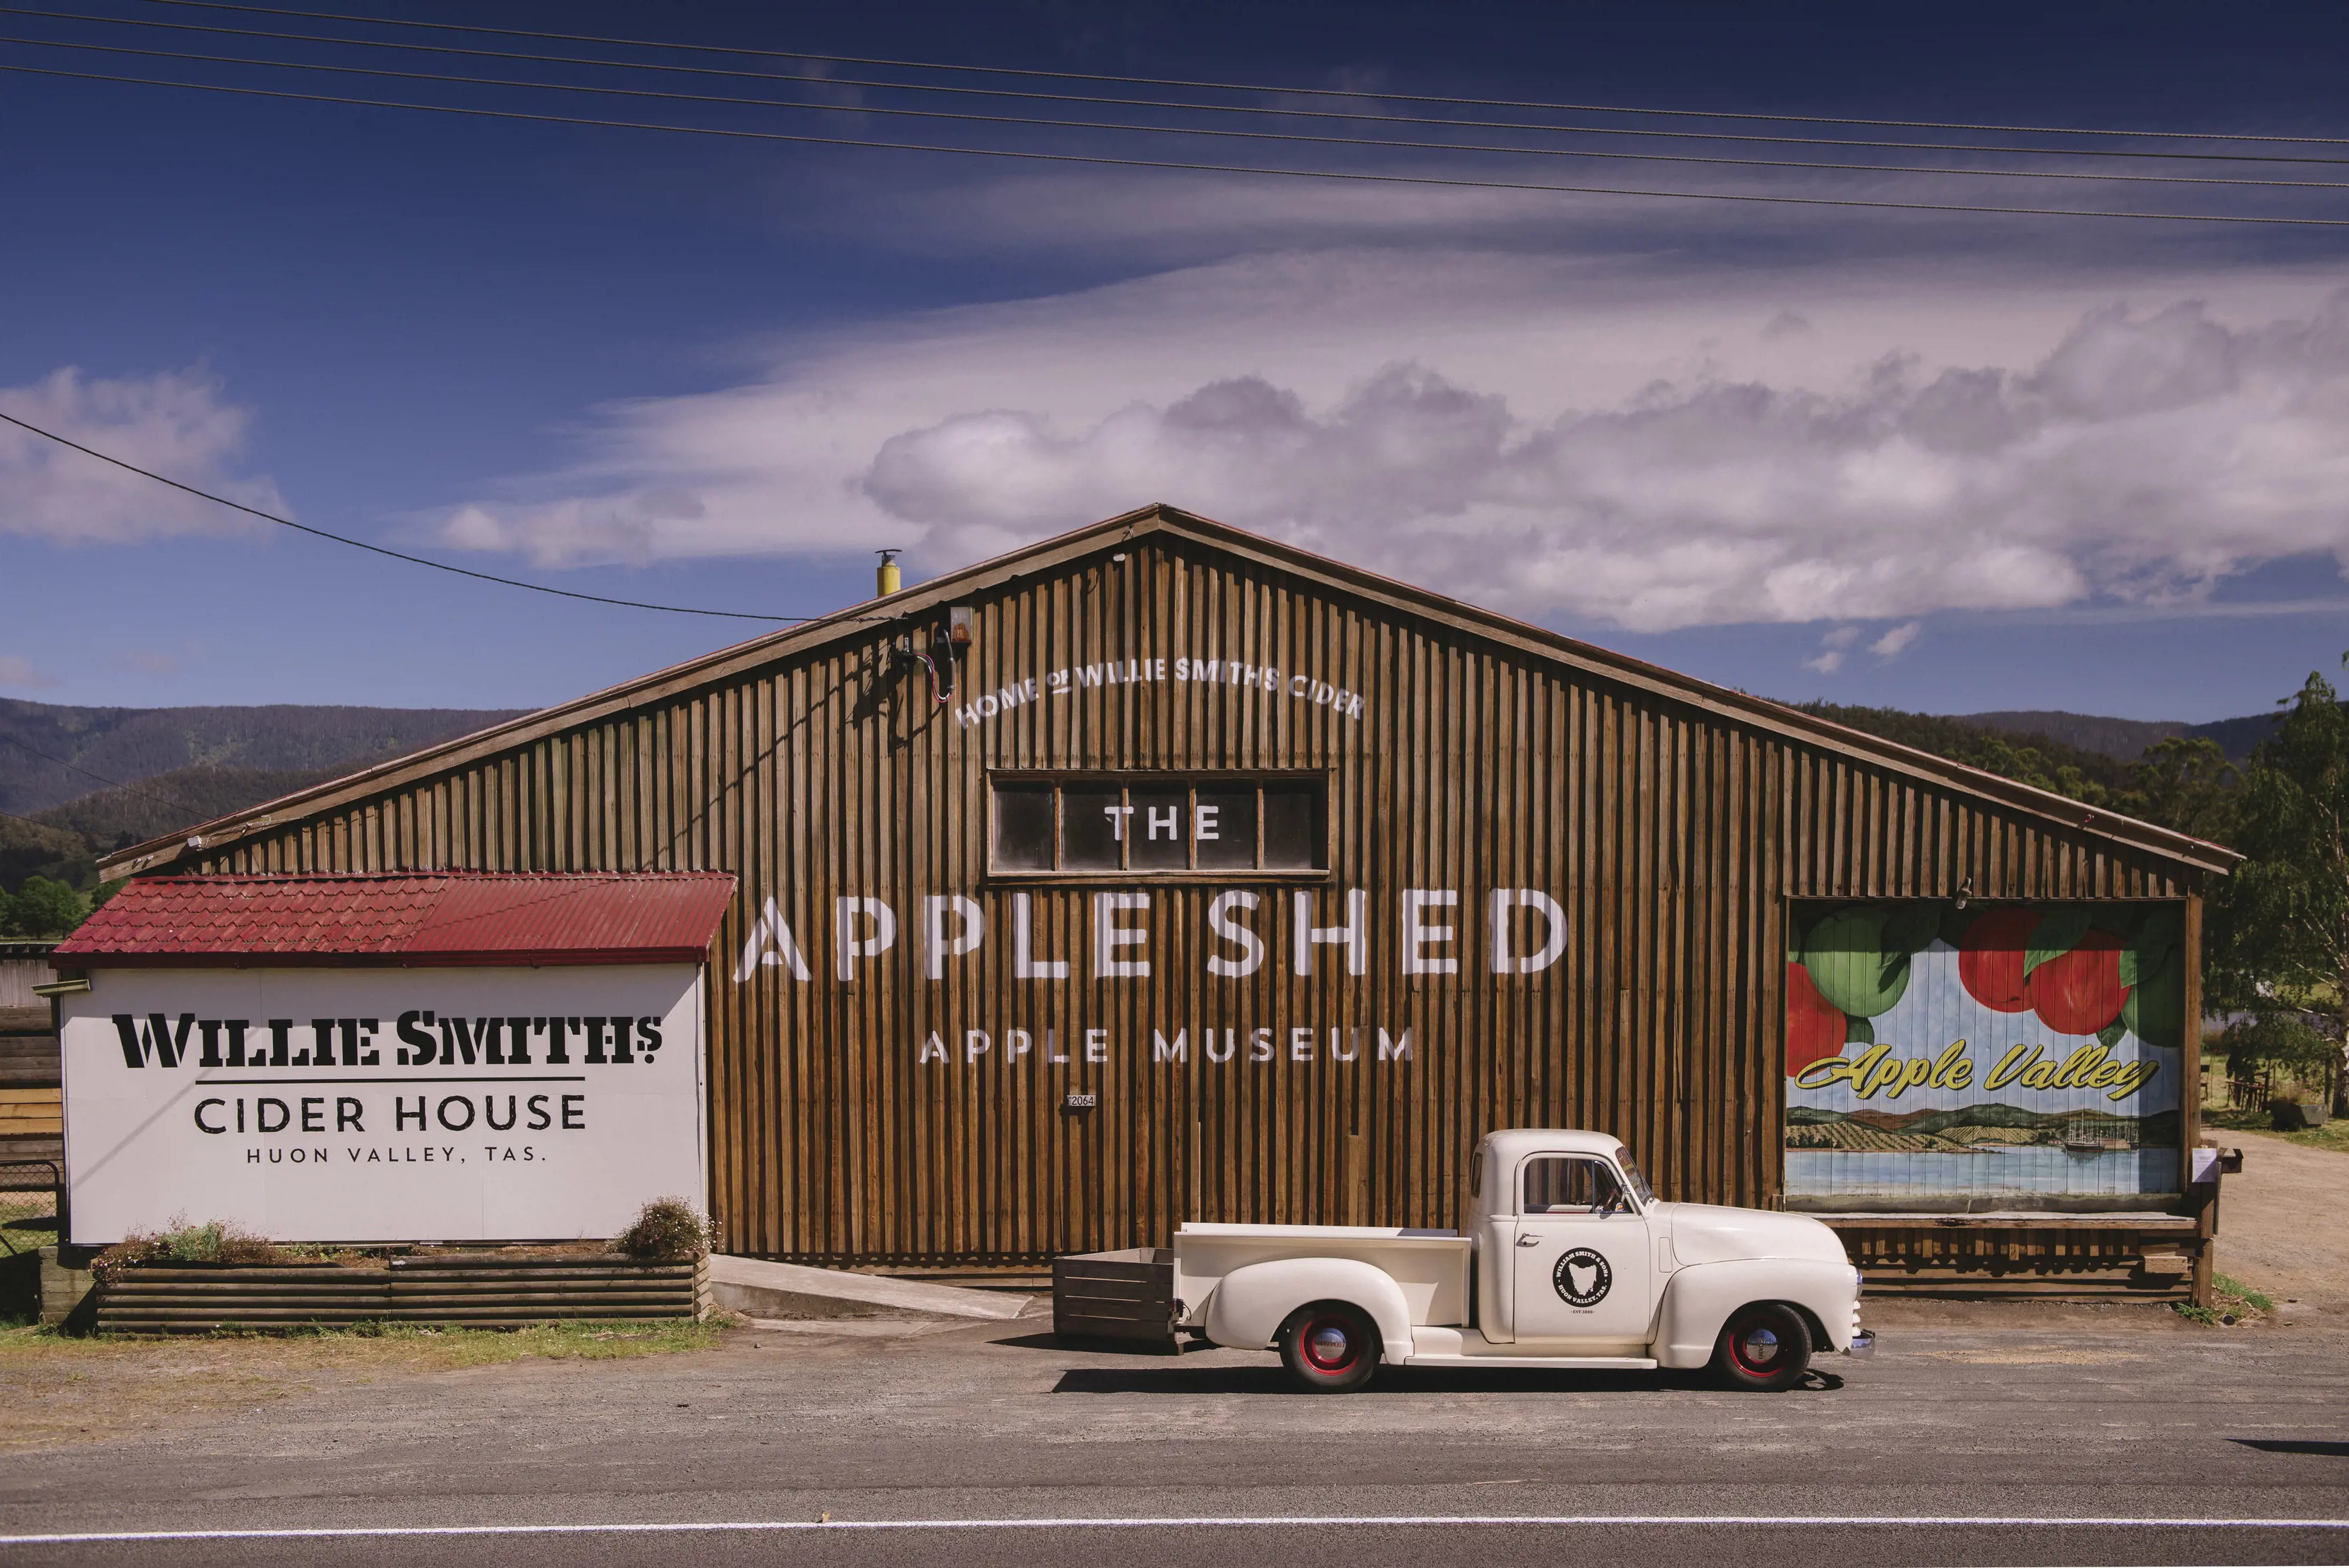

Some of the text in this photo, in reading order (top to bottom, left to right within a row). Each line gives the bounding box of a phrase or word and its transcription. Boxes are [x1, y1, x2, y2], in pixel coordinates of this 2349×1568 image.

[955, 657, 1365, 730] HOME OF WILLIE SMITHS CIDER
[1104, 805, 1219, 840] THE
[732, 887, 1568, 982] APPLE SHED
[111, 1013, 380, 1068] WILLIE
[919, 1027, 1413, 1063] APPLE MUSEUM
[1794, 1038, 2161, 1102] Apple Valley
[195, 1094, 586, 1135] CIDER HOUSE
[1072, 1096, 1094, 1106] 2064
[247, 1146, 547, 1164] HUON VALLEY, TAS.
[1556, 1253, 1575, 1277] WILLIAM
[1558, 1284, 1572, 1300] HUON
[1596, 1285, 1607, 1297] TAS.
